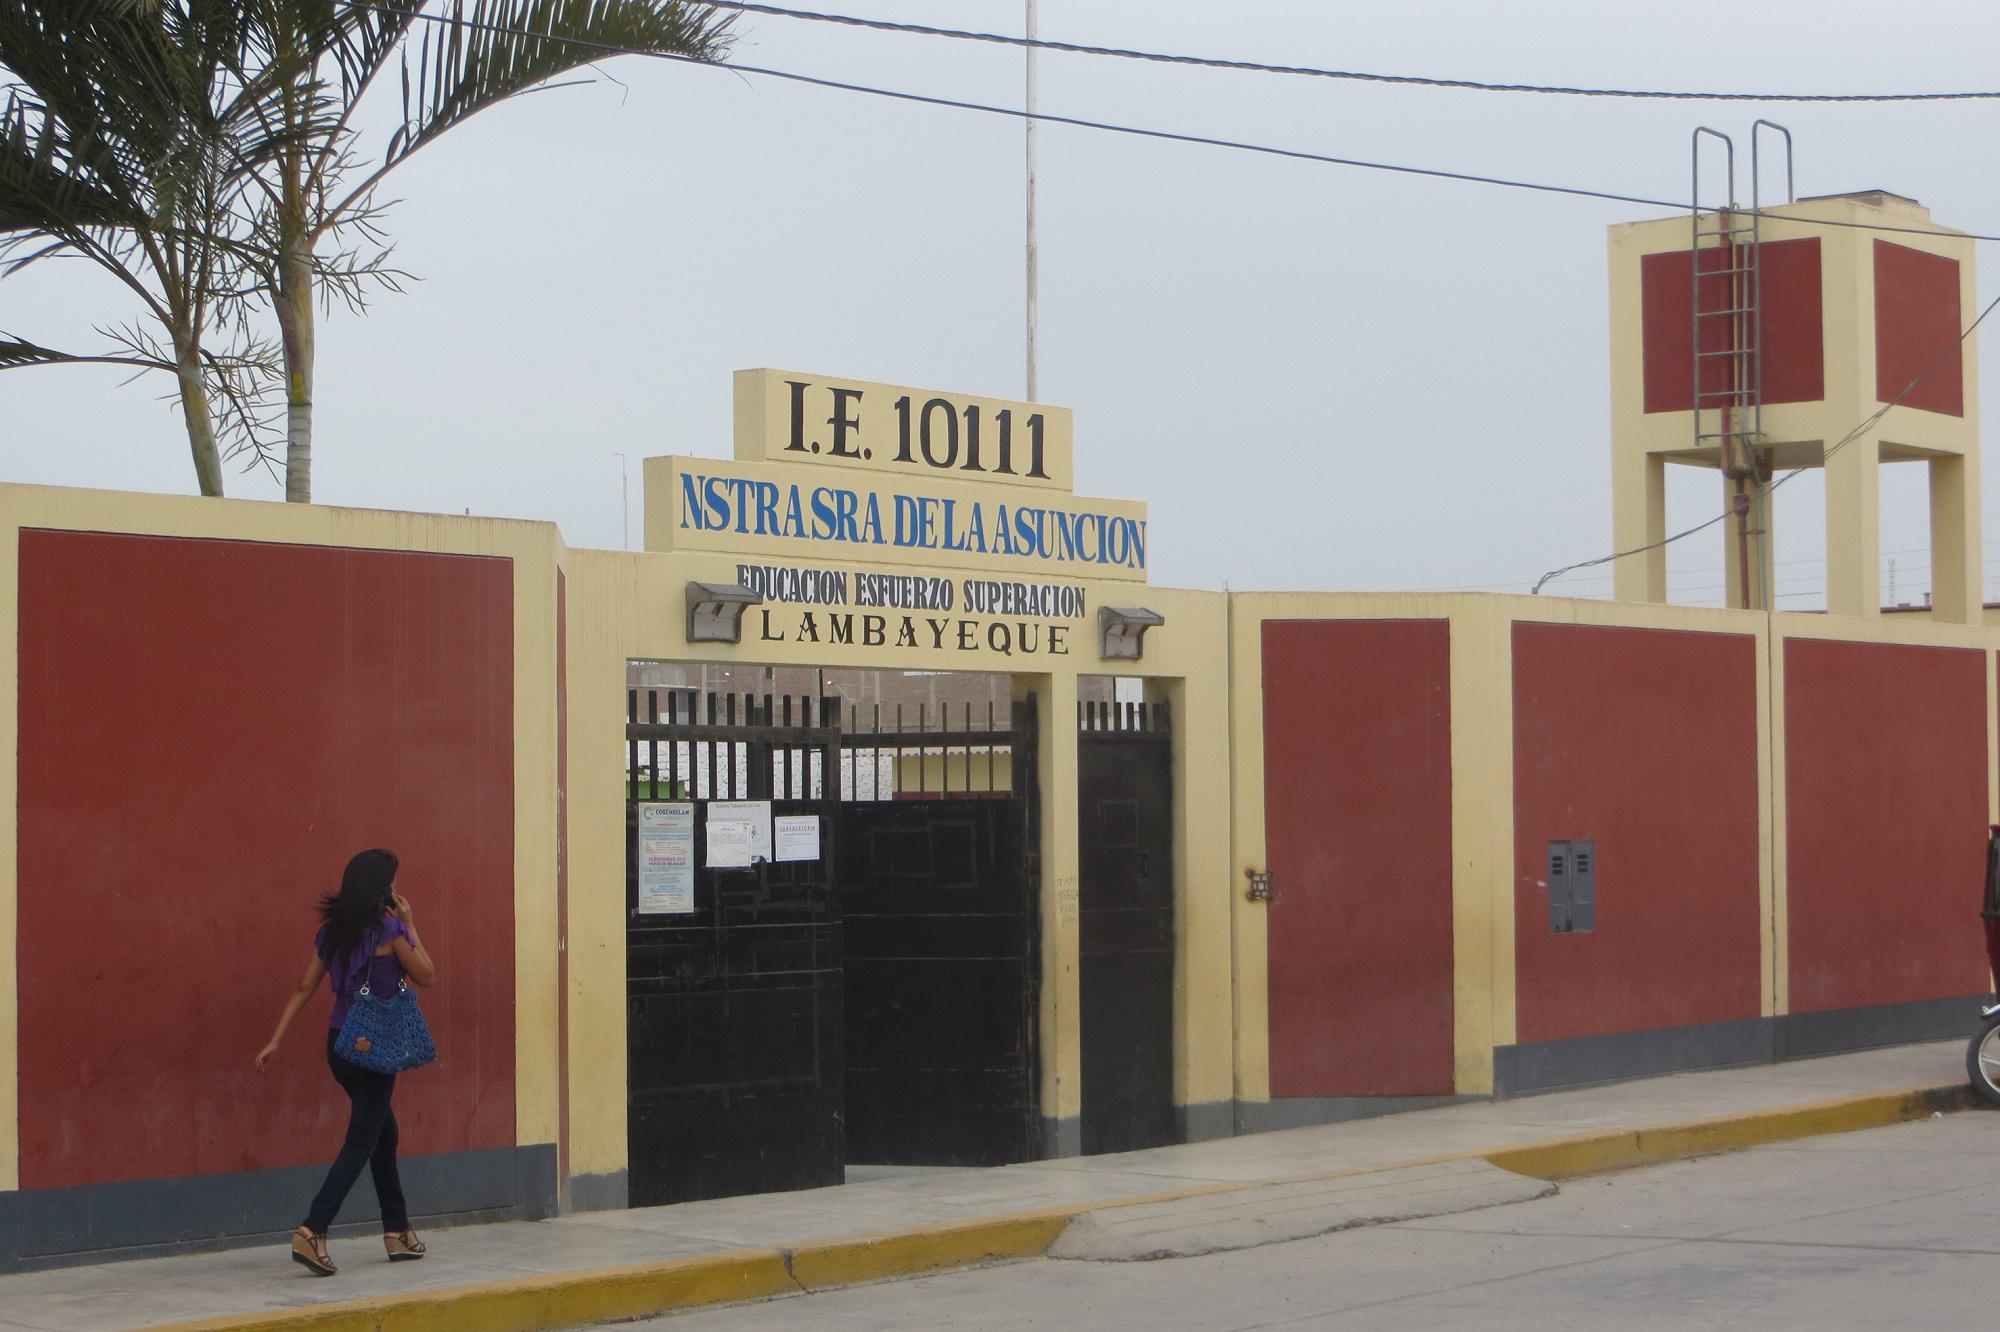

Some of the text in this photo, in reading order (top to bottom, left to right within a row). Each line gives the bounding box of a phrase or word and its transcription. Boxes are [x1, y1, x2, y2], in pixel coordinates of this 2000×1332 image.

[784, 380, 1051, 480] I.E. 10111
[893, 494, 939, 549] DE
[941, 499, 988, 554] LA
[991, 504, 1147, 569] ASUNCION
[736, 564, 1086, 618] EDUCACION ESFUERZO SUPERACION
[761, 609, 1070, 657] LAMBAYEQUE
